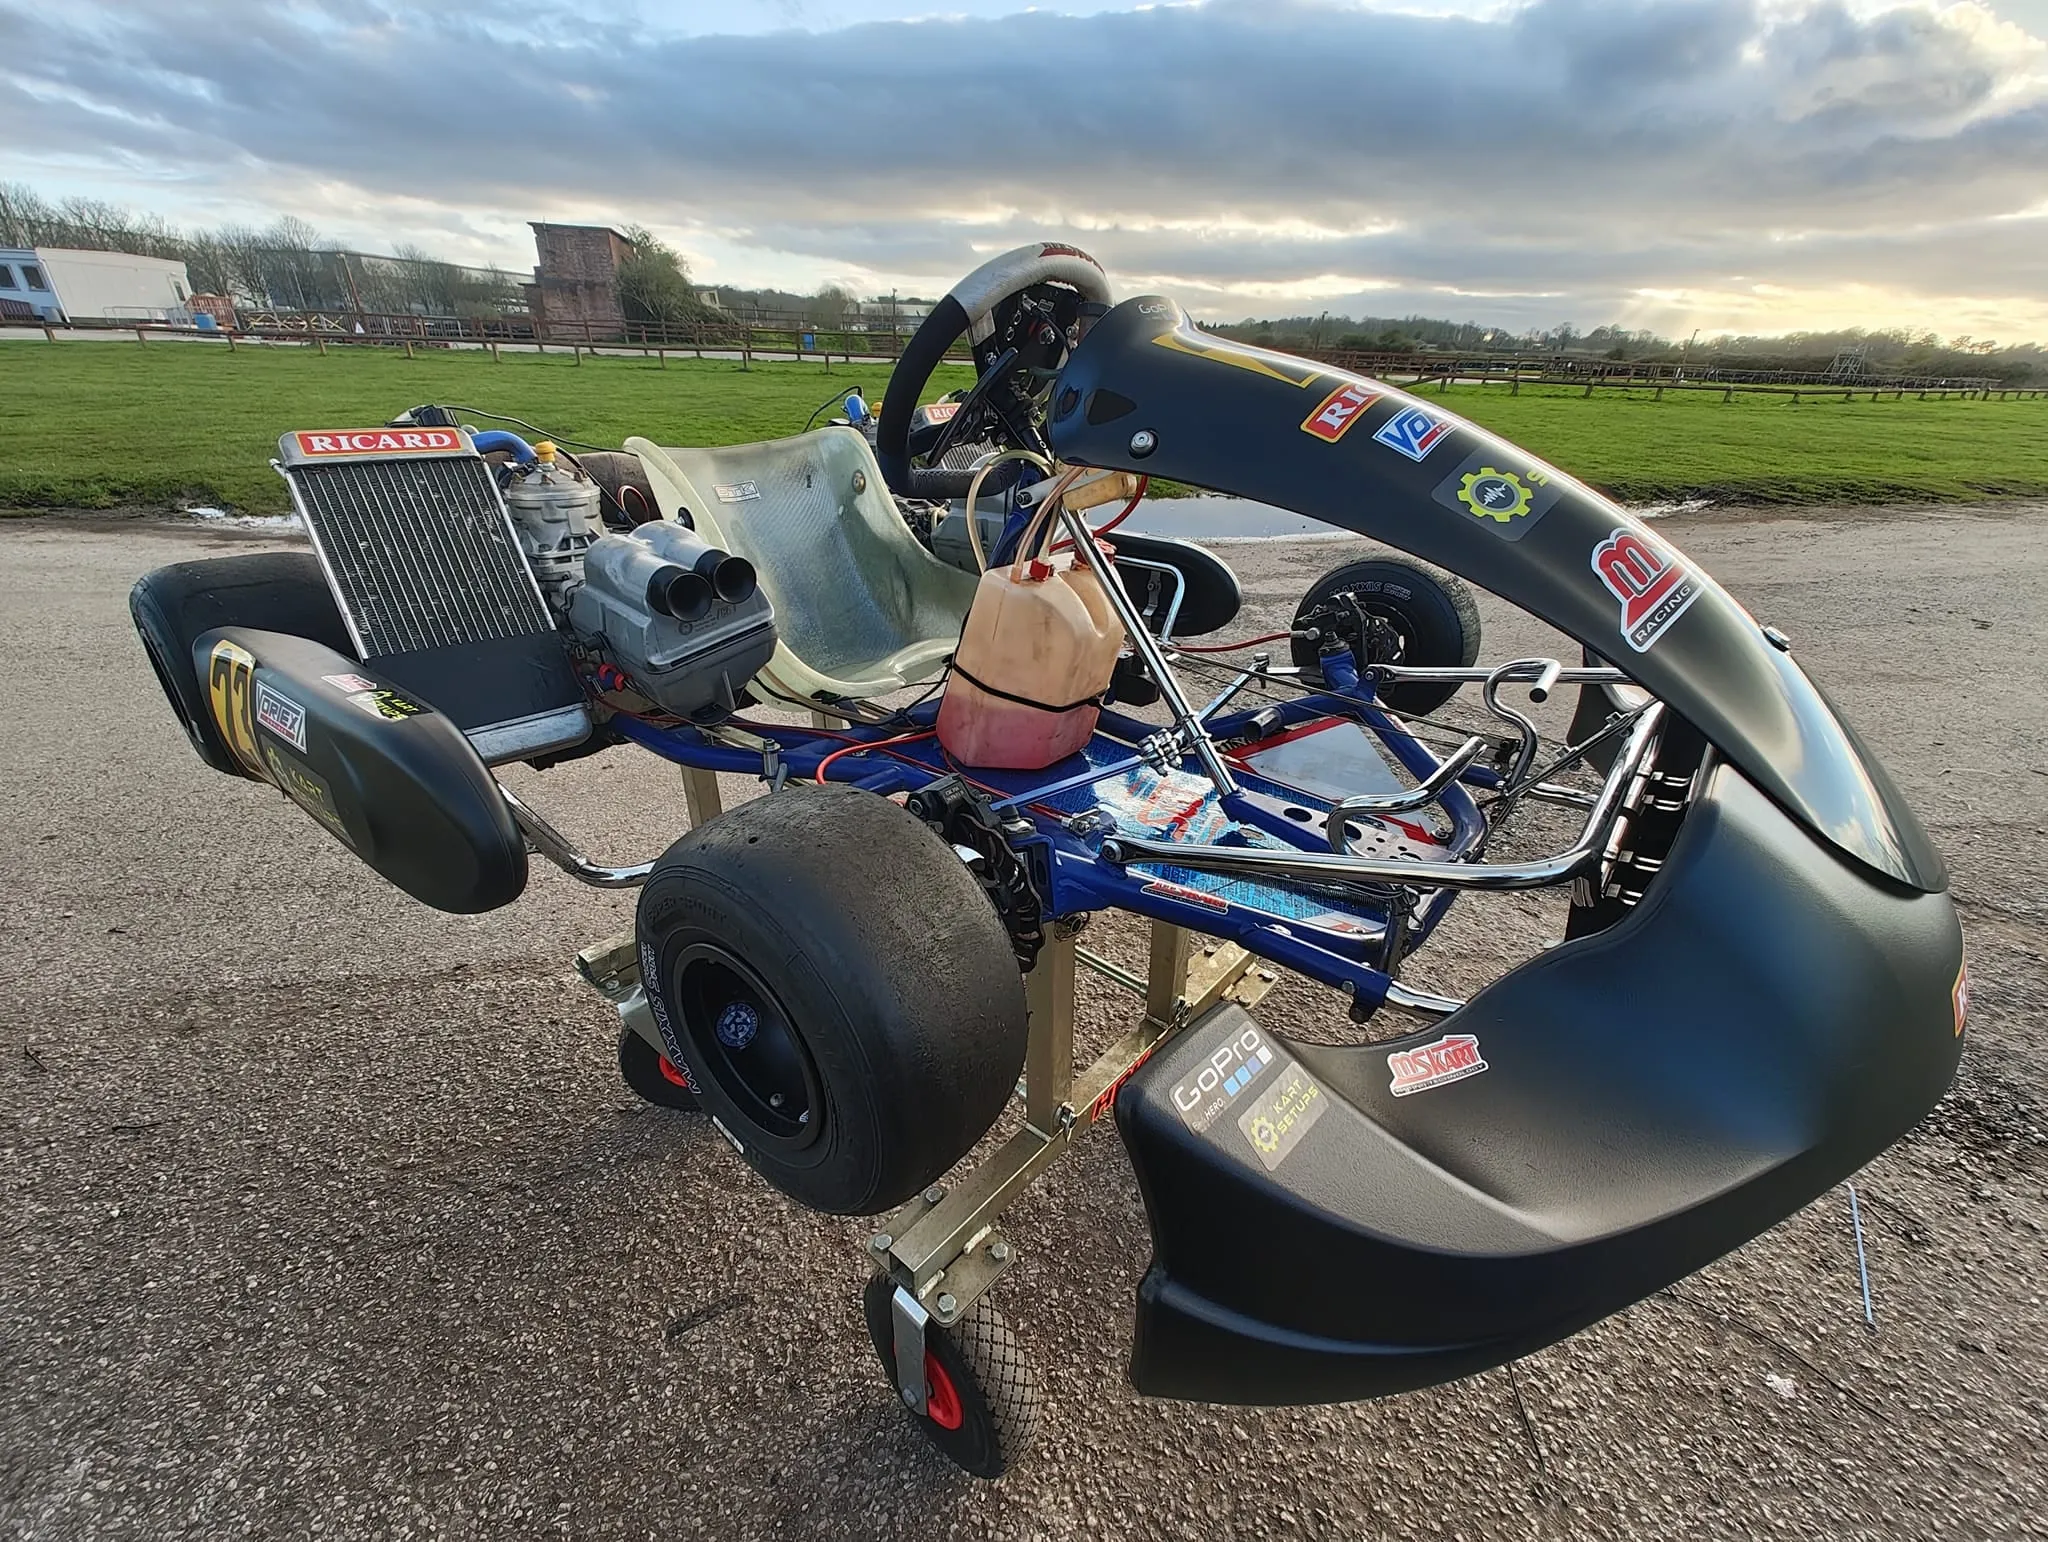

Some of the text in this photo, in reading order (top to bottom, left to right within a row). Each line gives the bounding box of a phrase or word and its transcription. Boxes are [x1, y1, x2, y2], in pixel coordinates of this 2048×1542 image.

[1138, 303, 1173, 315] GoP
[308, 432, 452, 452] RICARD
[1635, 585, 1692, 641] RACING
[651, 995, 702, 1095] MAXXIS
[1391, 1040, 1477, 1086] MSKART
[1174, 1030, 1260, 1112] GoPro
[1272, 1079, 1303, 1114] KART
[1276, 1086, 1319, 1135] SETUPS
